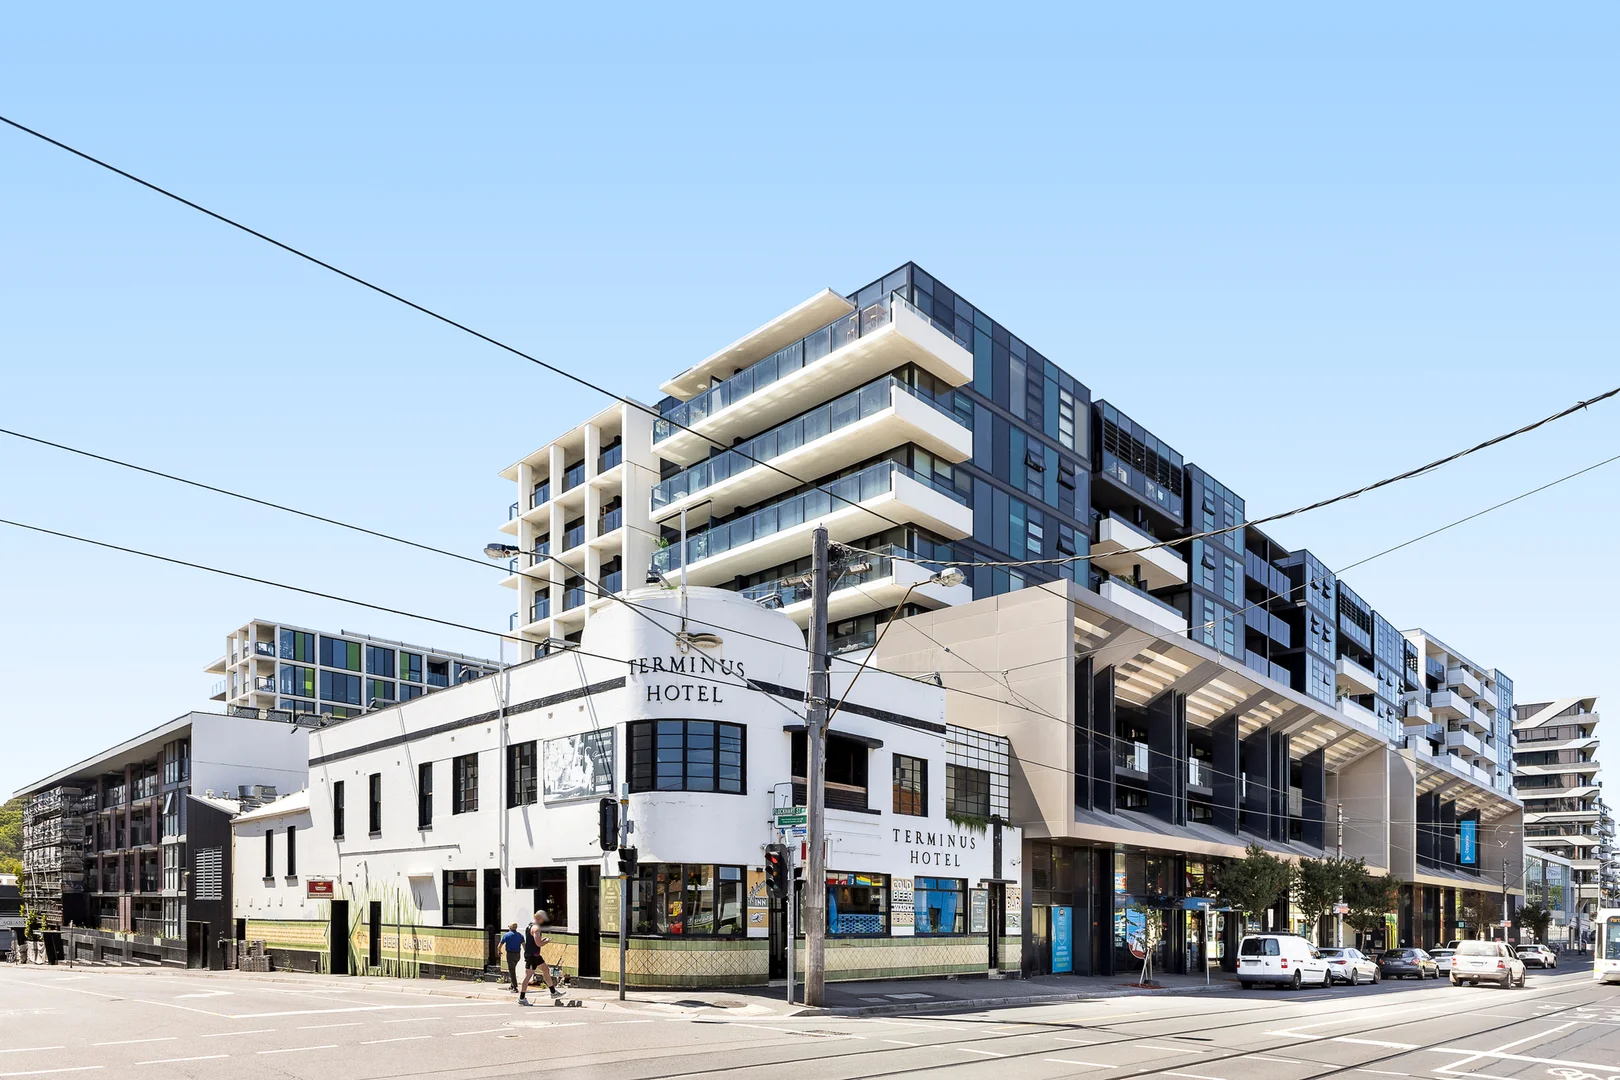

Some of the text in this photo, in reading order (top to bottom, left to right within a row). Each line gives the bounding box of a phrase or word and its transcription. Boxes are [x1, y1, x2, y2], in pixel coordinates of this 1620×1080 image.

[628, 656, 745, 676] TERMINUS
[647, 684, 723, 703] HOTEL
[893, 828, 976, 850] TERMINUS
[910, 850, 961, 868] HOTEL
[893, 879, 913, 890] COLD
[893, 890, 913, 902] BEER
[403, 936, 433, 951] GARDEN
